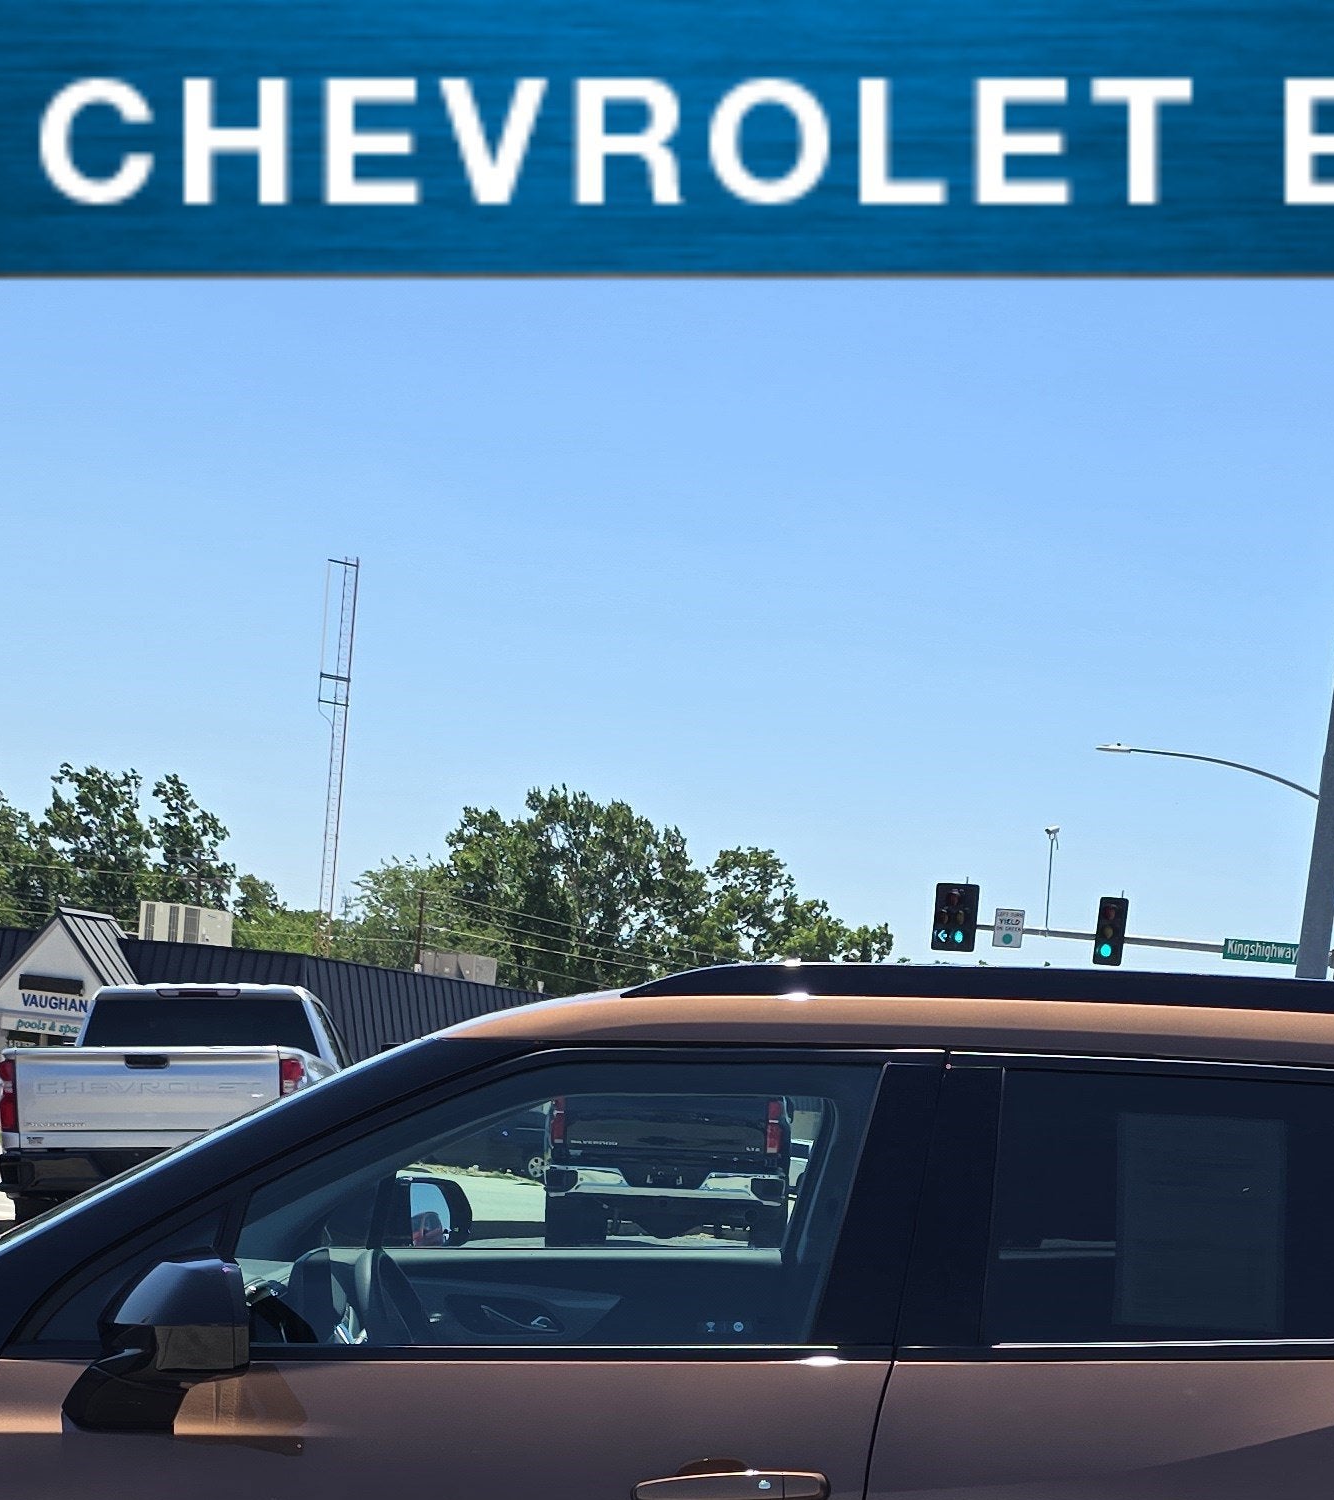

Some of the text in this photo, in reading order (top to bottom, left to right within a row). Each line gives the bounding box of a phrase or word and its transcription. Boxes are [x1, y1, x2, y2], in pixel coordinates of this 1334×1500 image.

[1227, 940, 1299, 962] Kingshighway
[22, 993, 89, 1013] VAUGHAN
[17, 1019, 46, 1031] pools
[36, 1081, 264, 1095] CHEVROLET
